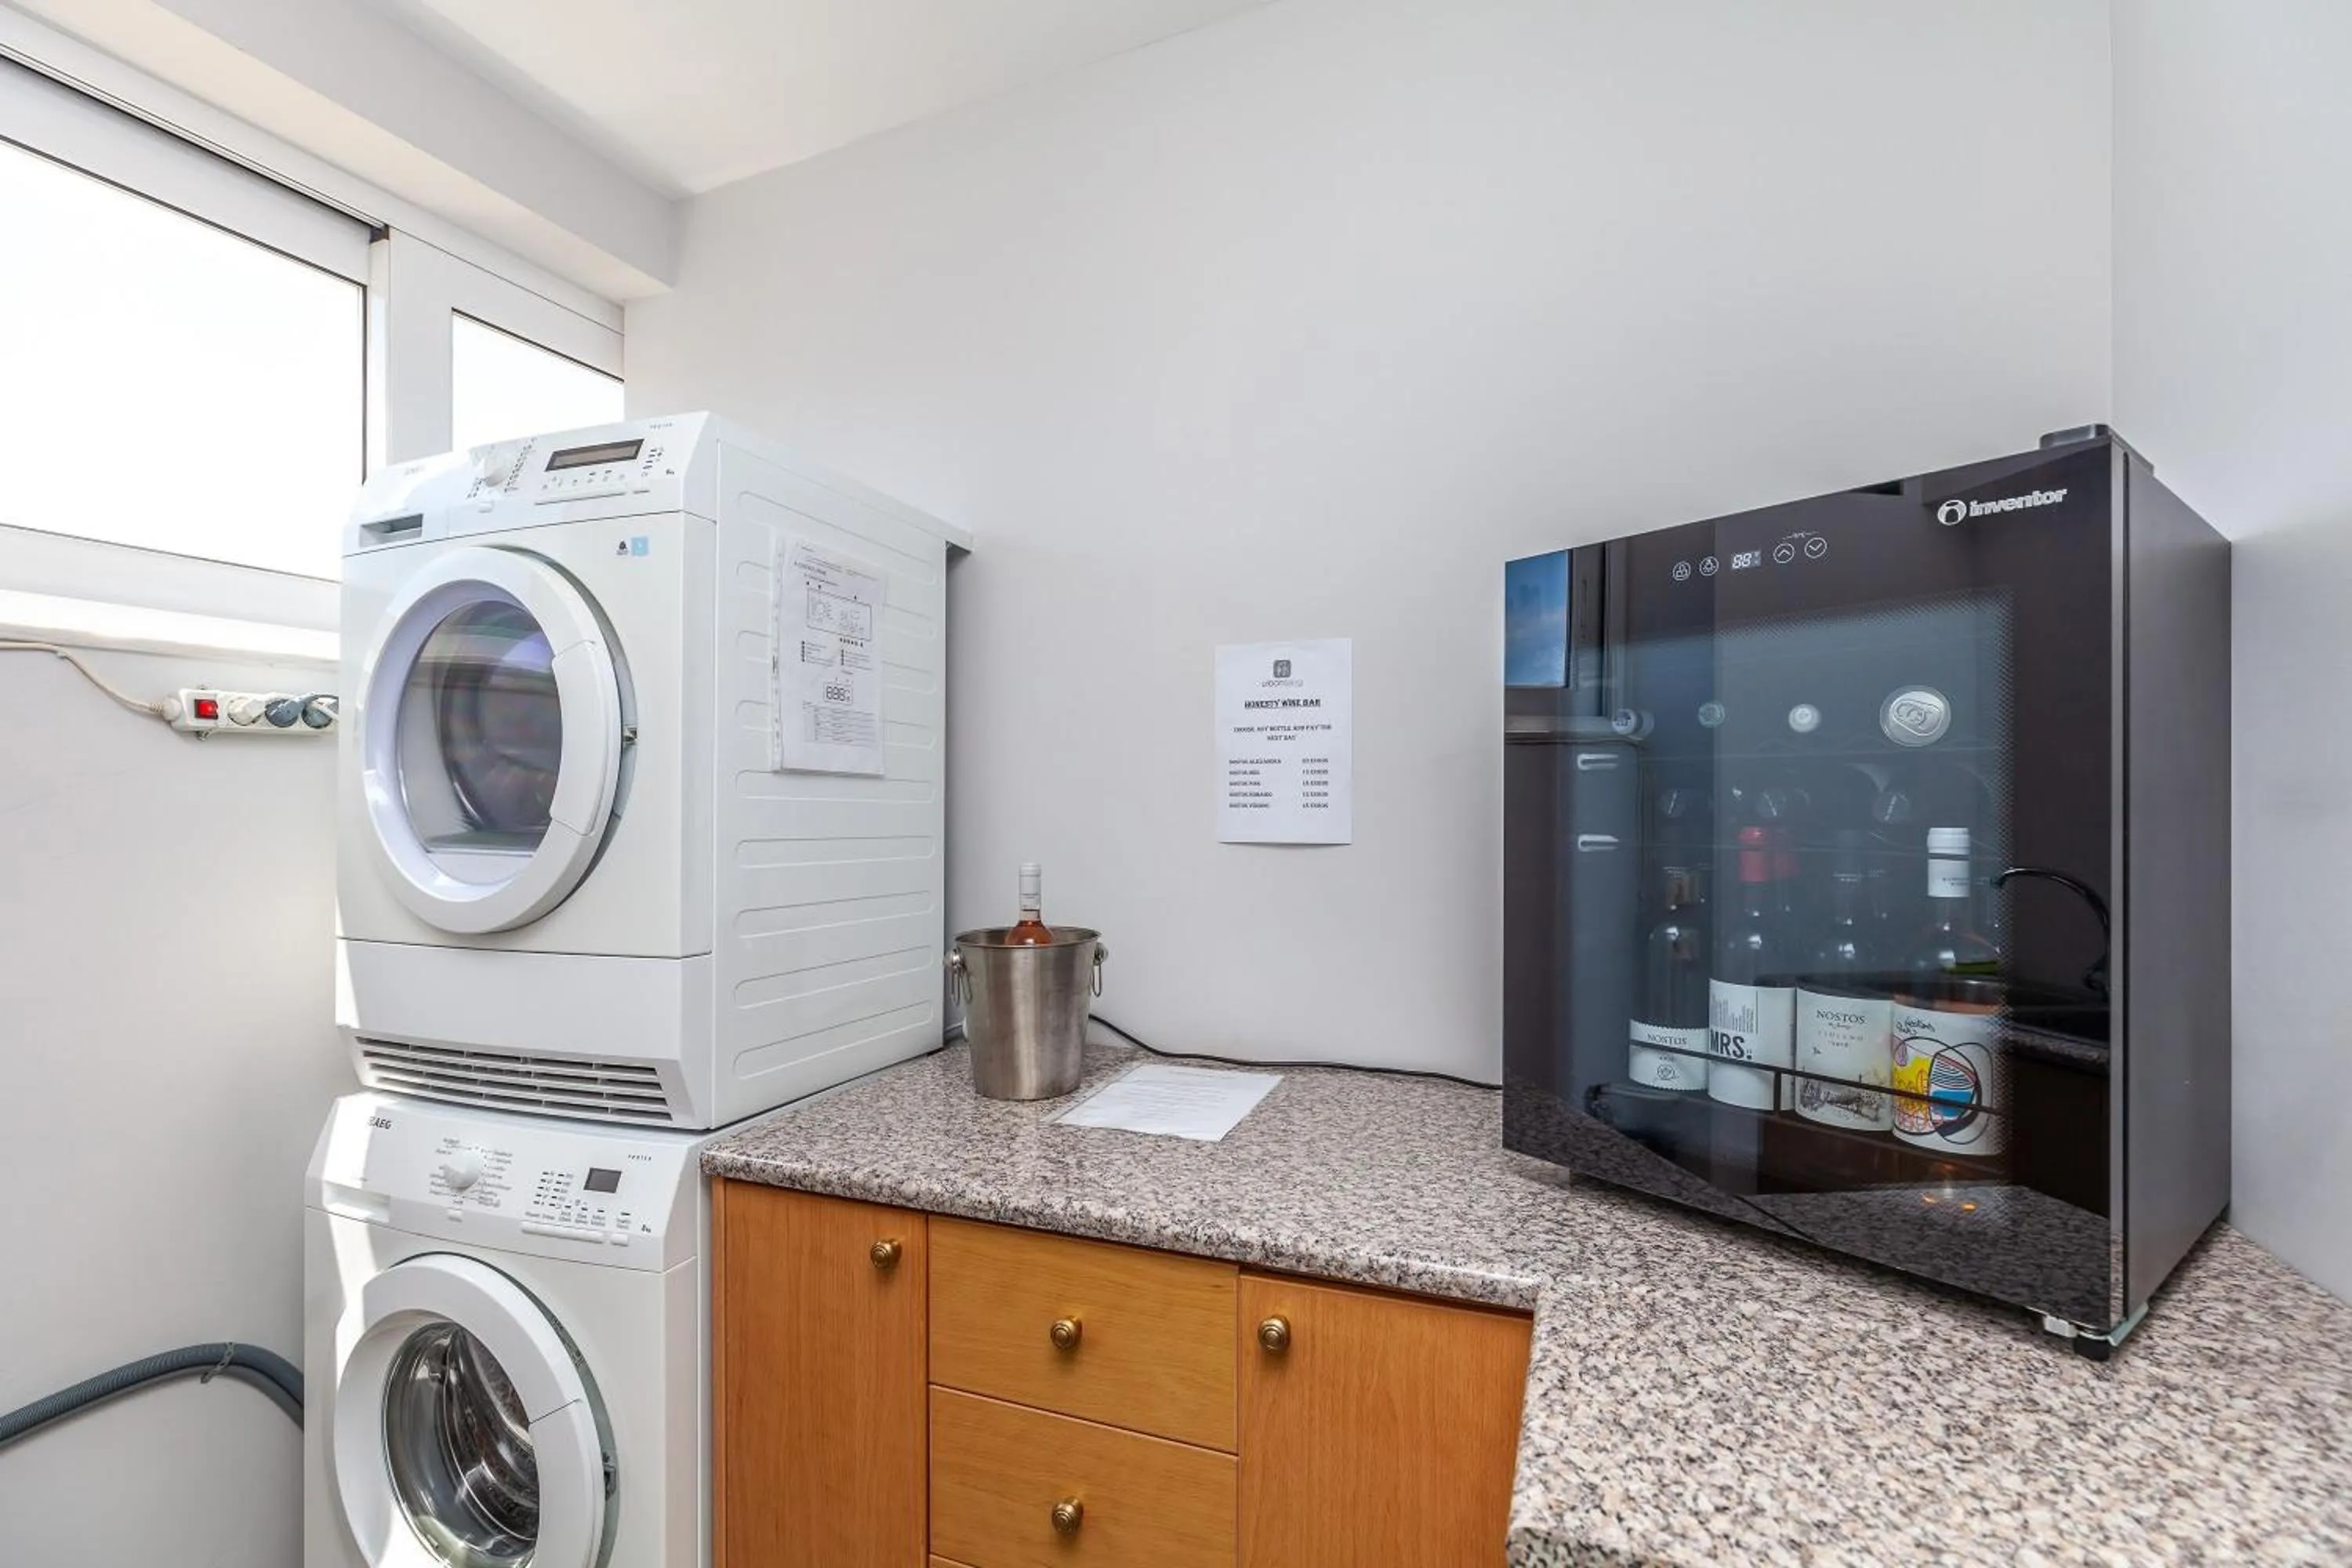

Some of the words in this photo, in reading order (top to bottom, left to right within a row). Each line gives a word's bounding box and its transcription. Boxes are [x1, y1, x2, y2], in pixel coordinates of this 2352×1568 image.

[1969, 488, 2067, 517] inventor
[1244, 699, 1279, 709] HONESTY
[1281, 699, 1301, 707] WINE
[1302, 699, 1321, 707] BAR
[1817, 1009, 1866, 1024] NOSTOS
[1647, 1033, 1688, 1045] NOSTOS
[375, 1117, 393, 1130] AEG
